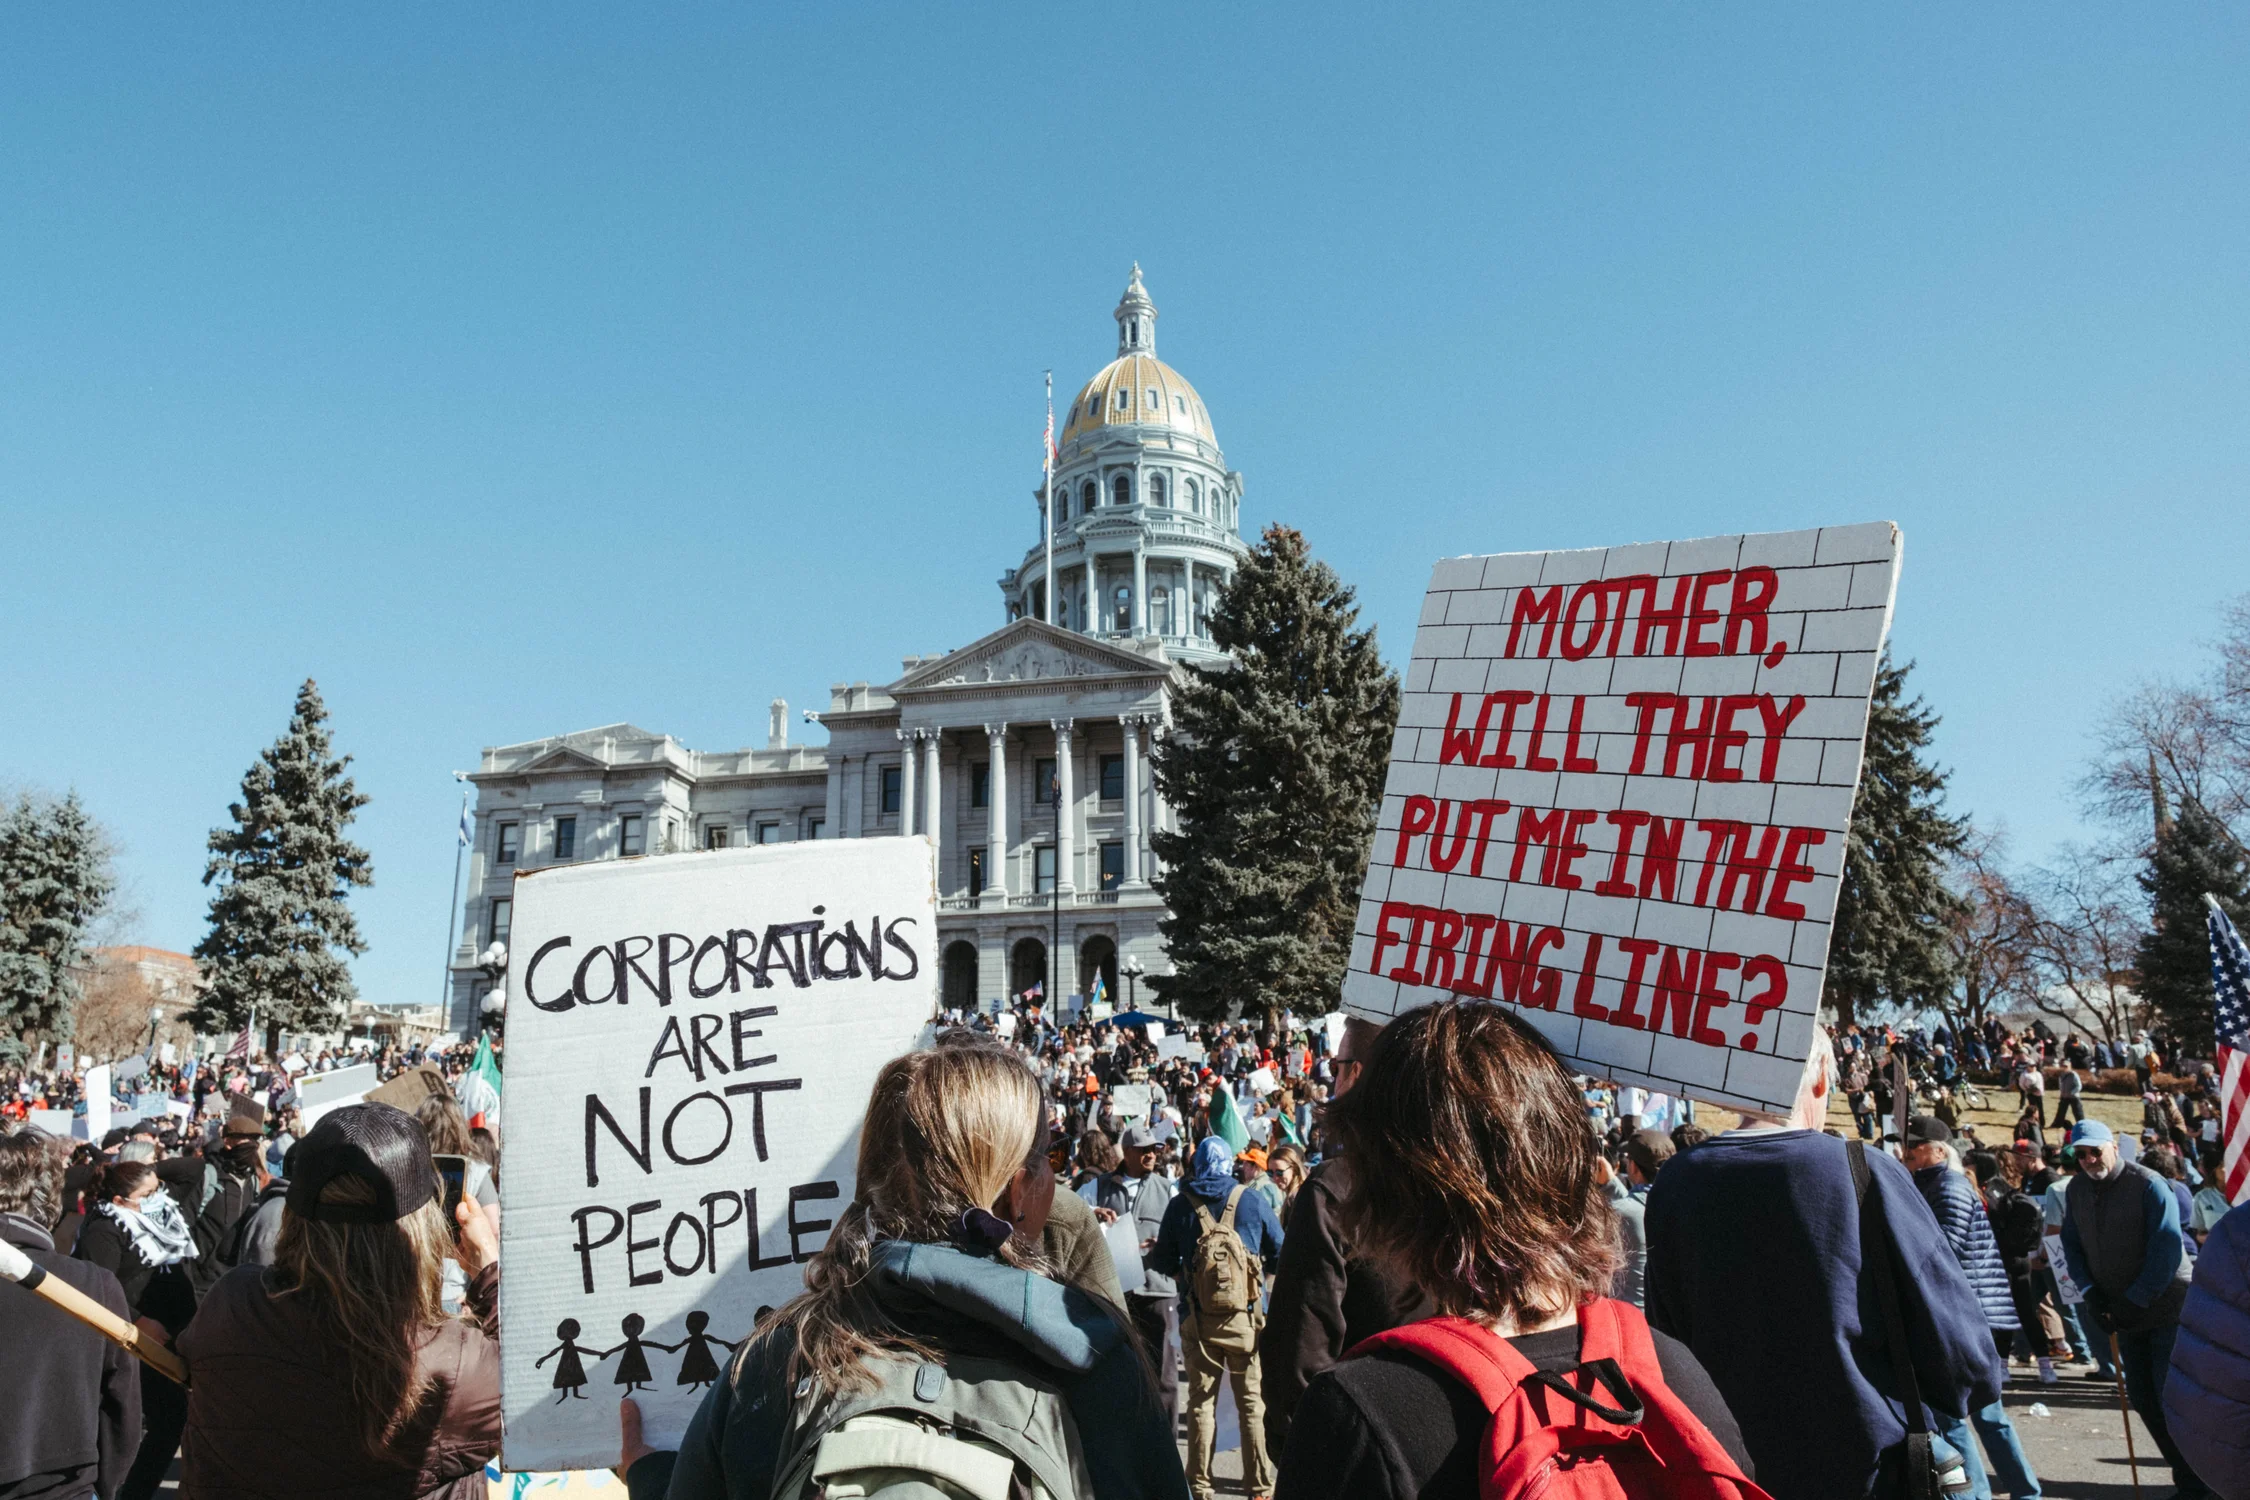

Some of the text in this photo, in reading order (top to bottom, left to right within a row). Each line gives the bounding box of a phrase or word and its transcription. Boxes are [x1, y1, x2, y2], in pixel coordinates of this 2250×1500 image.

[1505, 566, 1787, 669] MOTHER,
[1440, 690, 1806, 783] WILL THEY
[1394, 795, 1826, 920] PUT ME IN THE
[1370, 902, 1788, 1051] FIRING LINE?
[645, 1006, 778, 1082] ARE
[585, 1078, 802, 1187] NOT
[571, 1181, 839, 1294] PEOPLE
